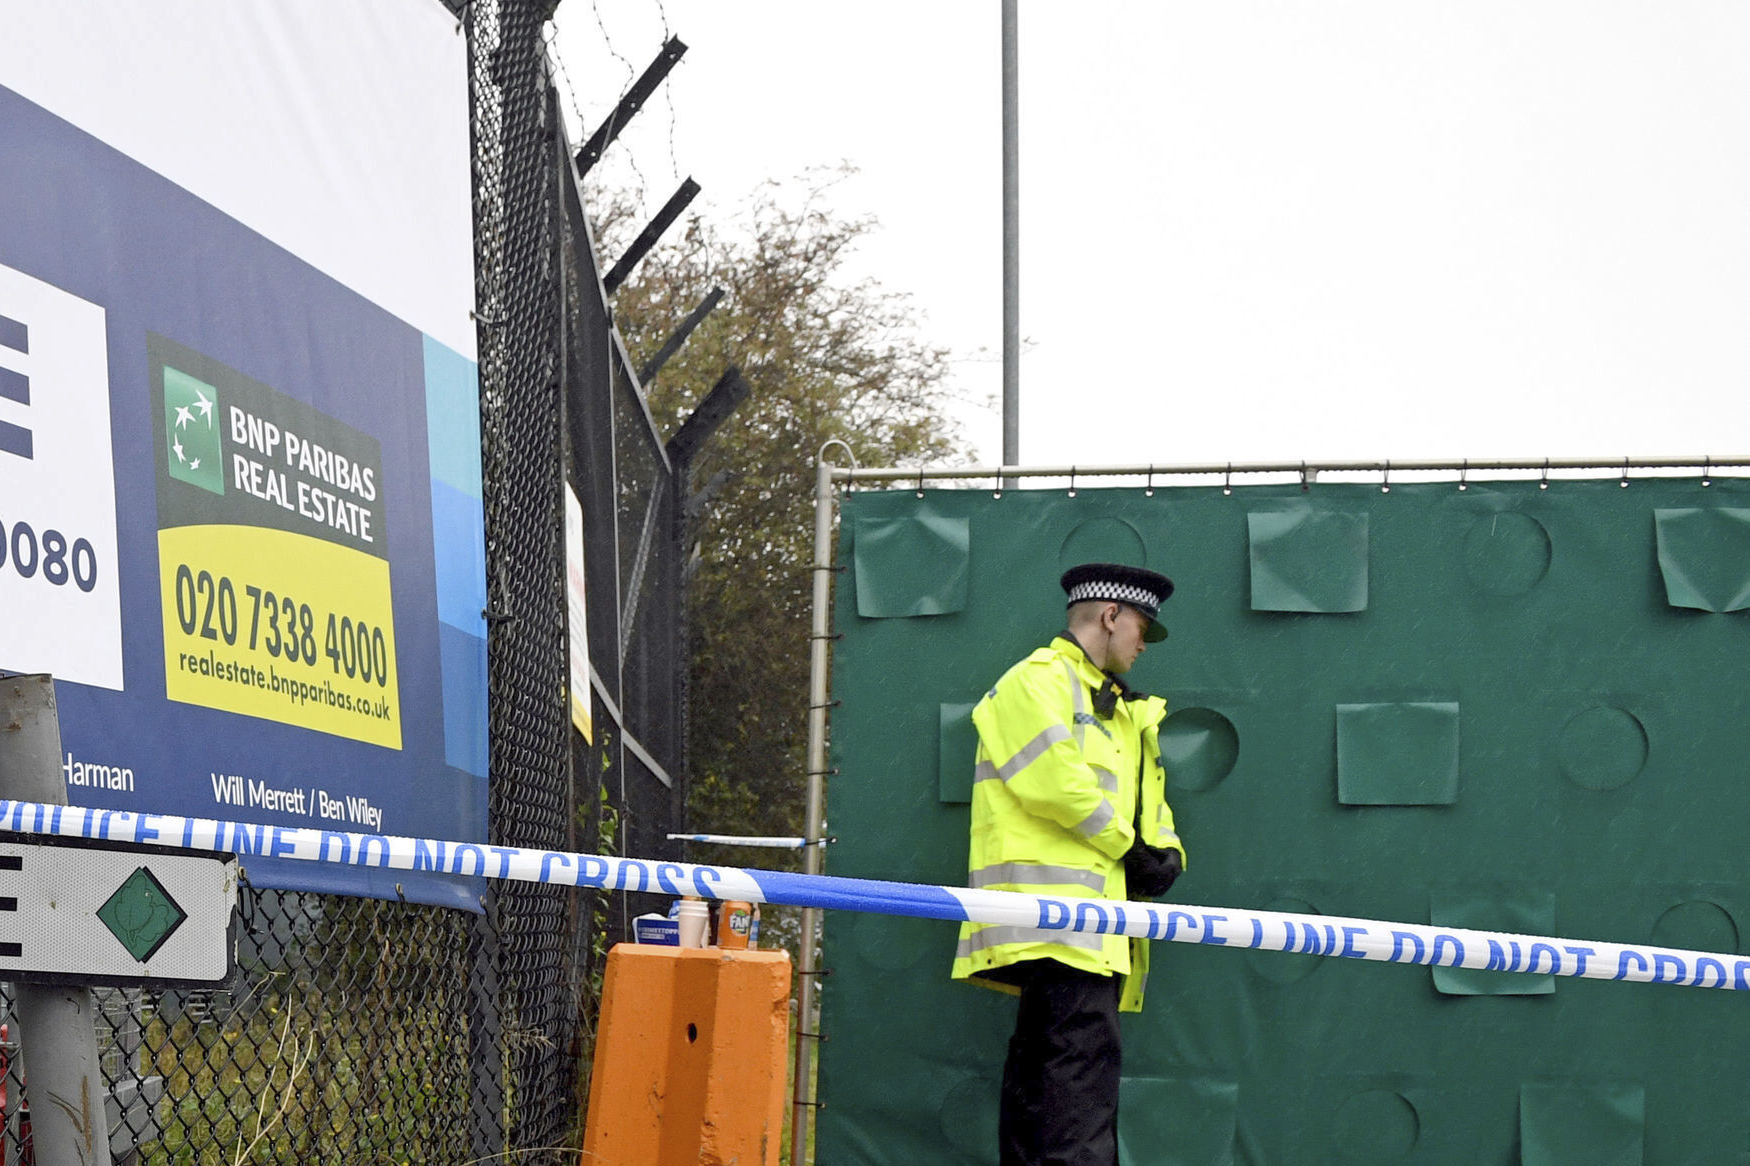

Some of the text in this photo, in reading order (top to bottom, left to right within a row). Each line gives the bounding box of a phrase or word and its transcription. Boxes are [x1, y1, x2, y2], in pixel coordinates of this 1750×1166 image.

[230, 404, 377, 502] BNP PARIBAS
[233, 453, 374, 543] REAL ESTATE
[175, 563, 388, 688] 020 7338 4000
[179, 650, 391, 721] realestate.bnpparibas.co.uk
[210, 772, 245, 806] Will
[248, 778, 307, 815] Merrett
[318, 790, 346, 821] Ben
[346, 795, 383, 832] Wiley
[413, 837, 520, 879] NOT
[539, 852, 722, 900] CROSS
[1036, 898, 1228, 945] POLICE
[1485, 938, 1597, 977] NOT
